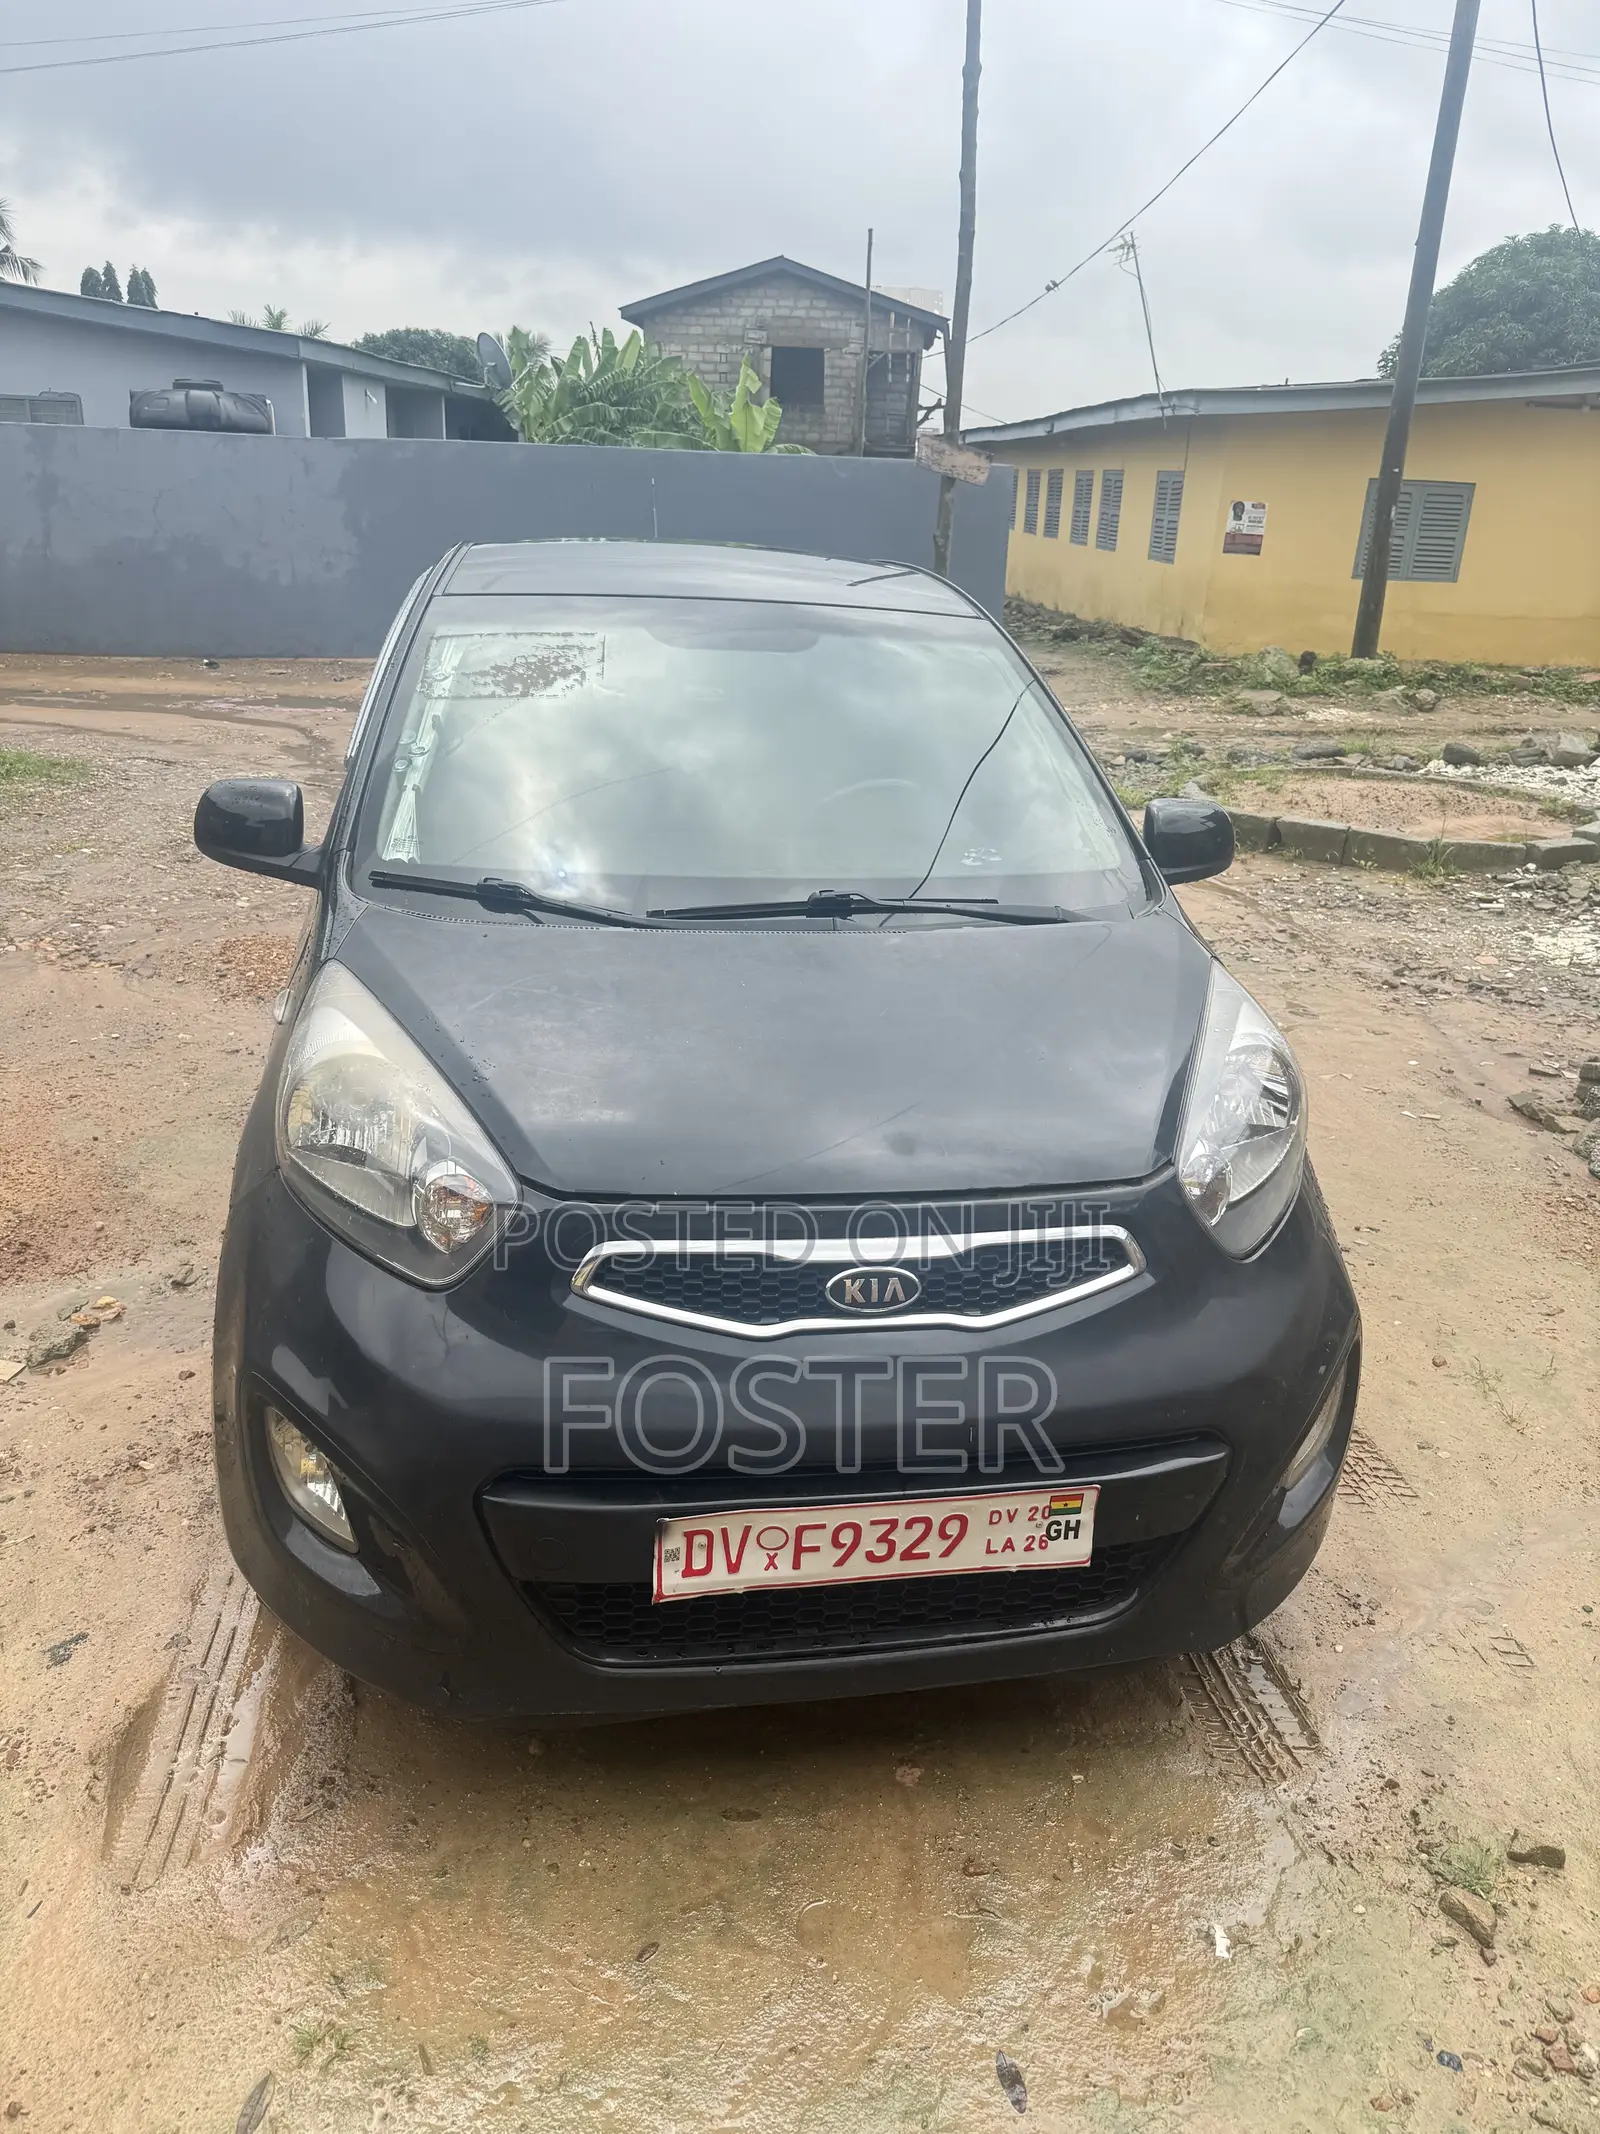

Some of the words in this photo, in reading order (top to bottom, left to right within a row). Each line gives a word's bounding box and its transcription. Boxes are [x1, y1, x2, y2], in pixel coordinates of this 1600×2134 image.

[843, 1277, 906, 1304] KIA
[988, 1507, 1019, 1526] DV
[1045, 1519, 1082, 1542] GH
[985, 1536, 1016, 1555] LA
[1023, 1533, 1049, 1552] 26
